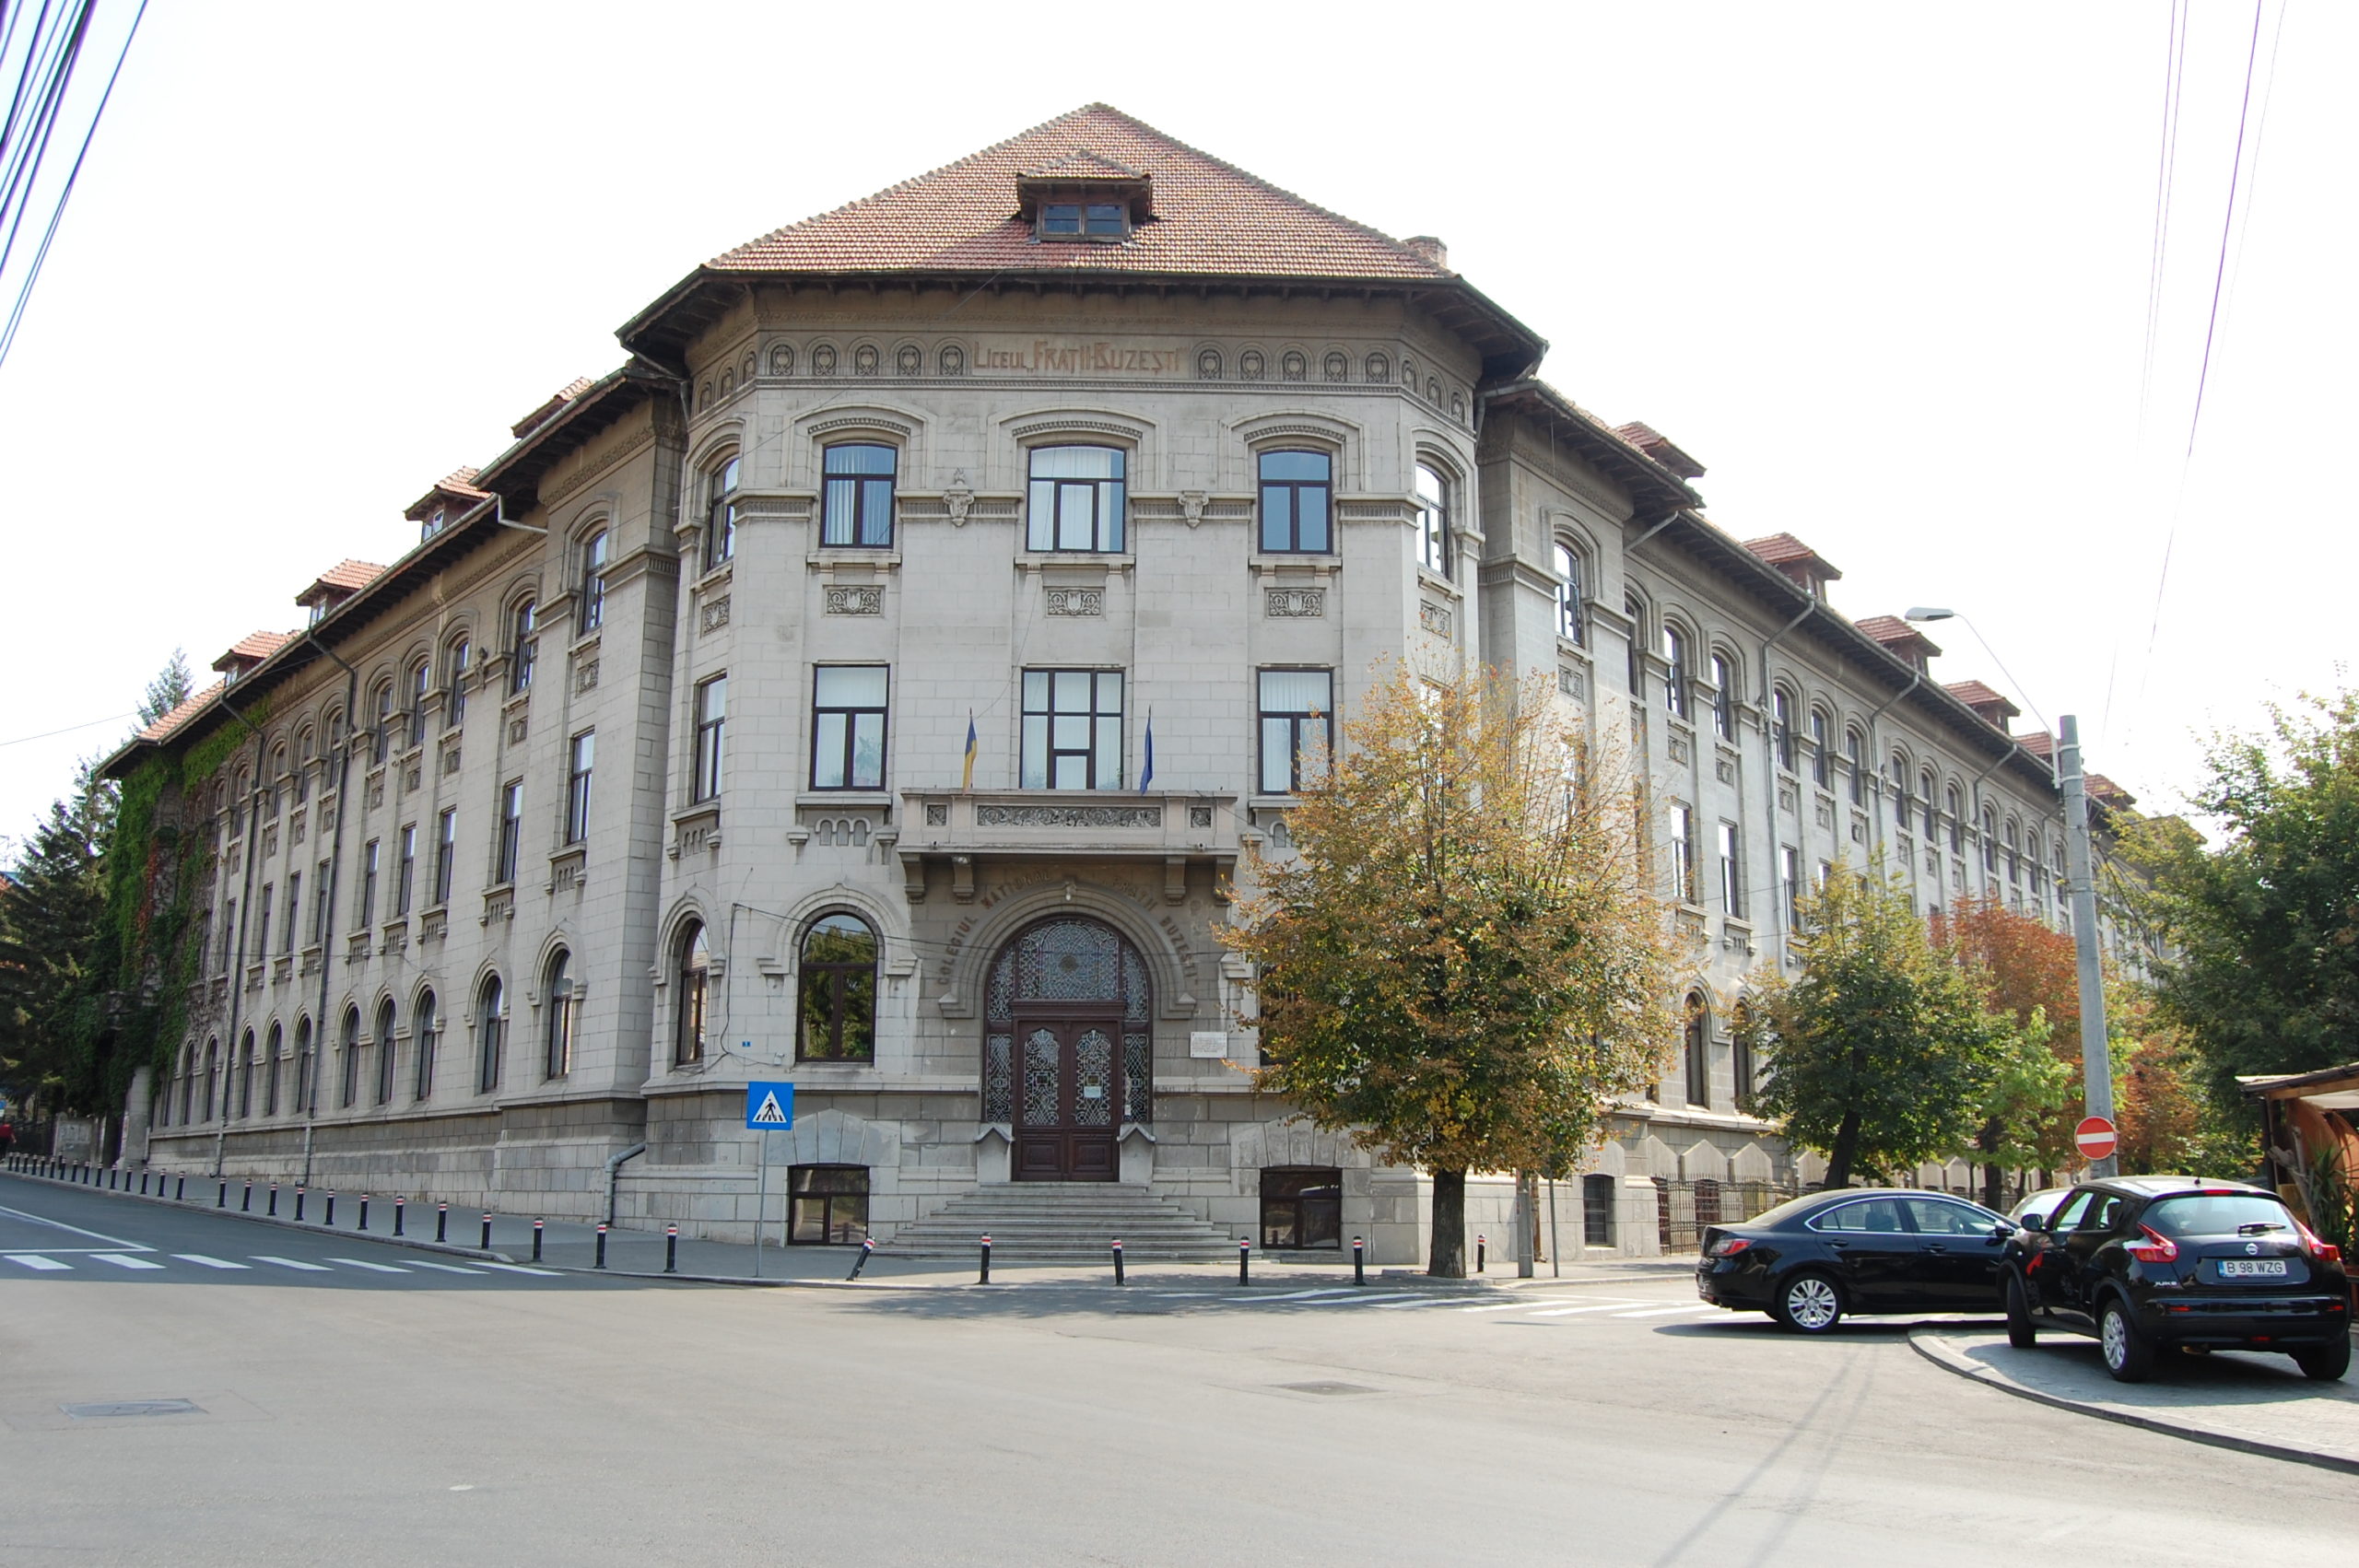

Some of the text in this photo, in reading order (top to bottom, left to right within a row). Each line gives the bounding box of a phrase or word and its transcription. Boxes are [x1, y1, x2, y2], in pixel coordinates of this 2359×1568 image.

[974, 341, 1027, 369] LICEUL
[937, 916, 979, 986] COLEGIUL
[2226, 1262, 2236, 1273] B
[2240, 1262, 2253, 1273] 98
[2257, 1262, 2283, 1273] WZG
